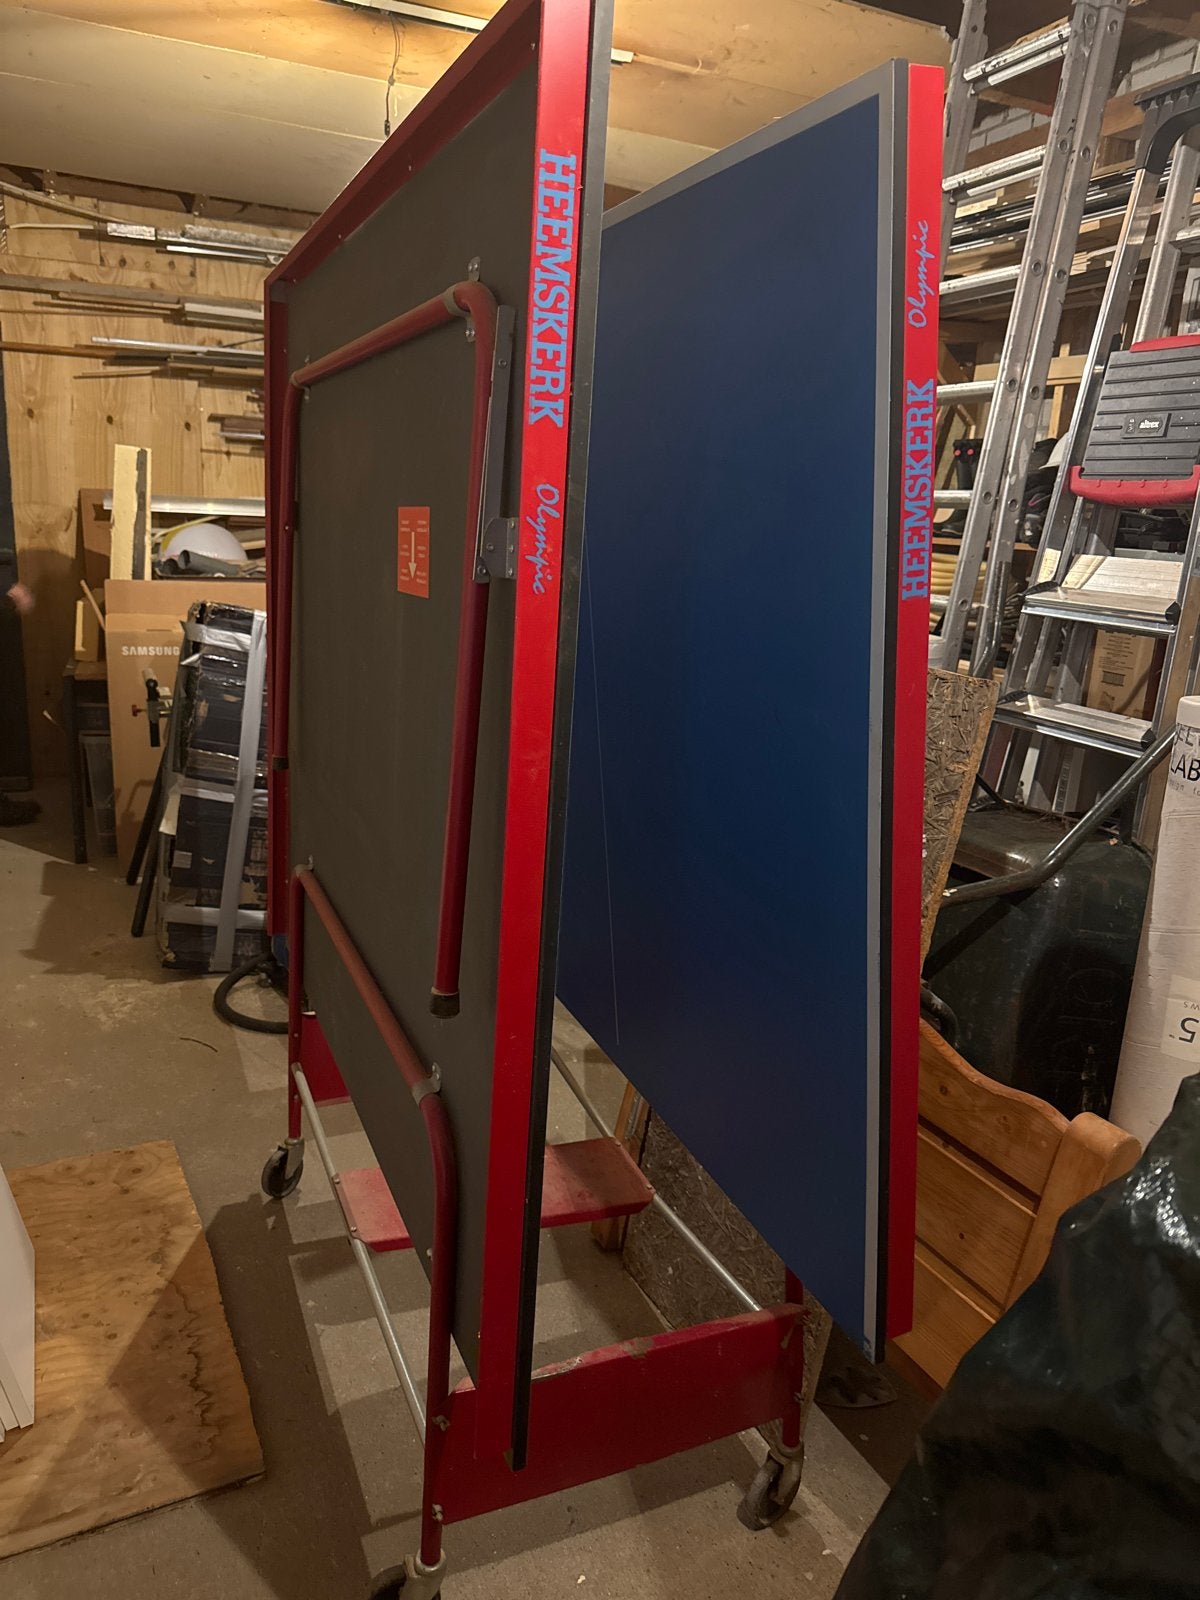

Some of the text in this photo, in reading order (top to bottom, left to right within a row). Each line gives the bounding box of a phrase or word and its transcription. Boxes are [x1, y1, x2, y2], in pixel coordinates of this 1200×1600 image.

[528, 148, 576, 428] HEEMSKERK
[907, 220, 935, 328] Olympic
[525, 483, 560, 595] Olympic
[902, 378, 934, 600] HEEMSKERK
[121, 646, 180, 656] SAMSUNG
